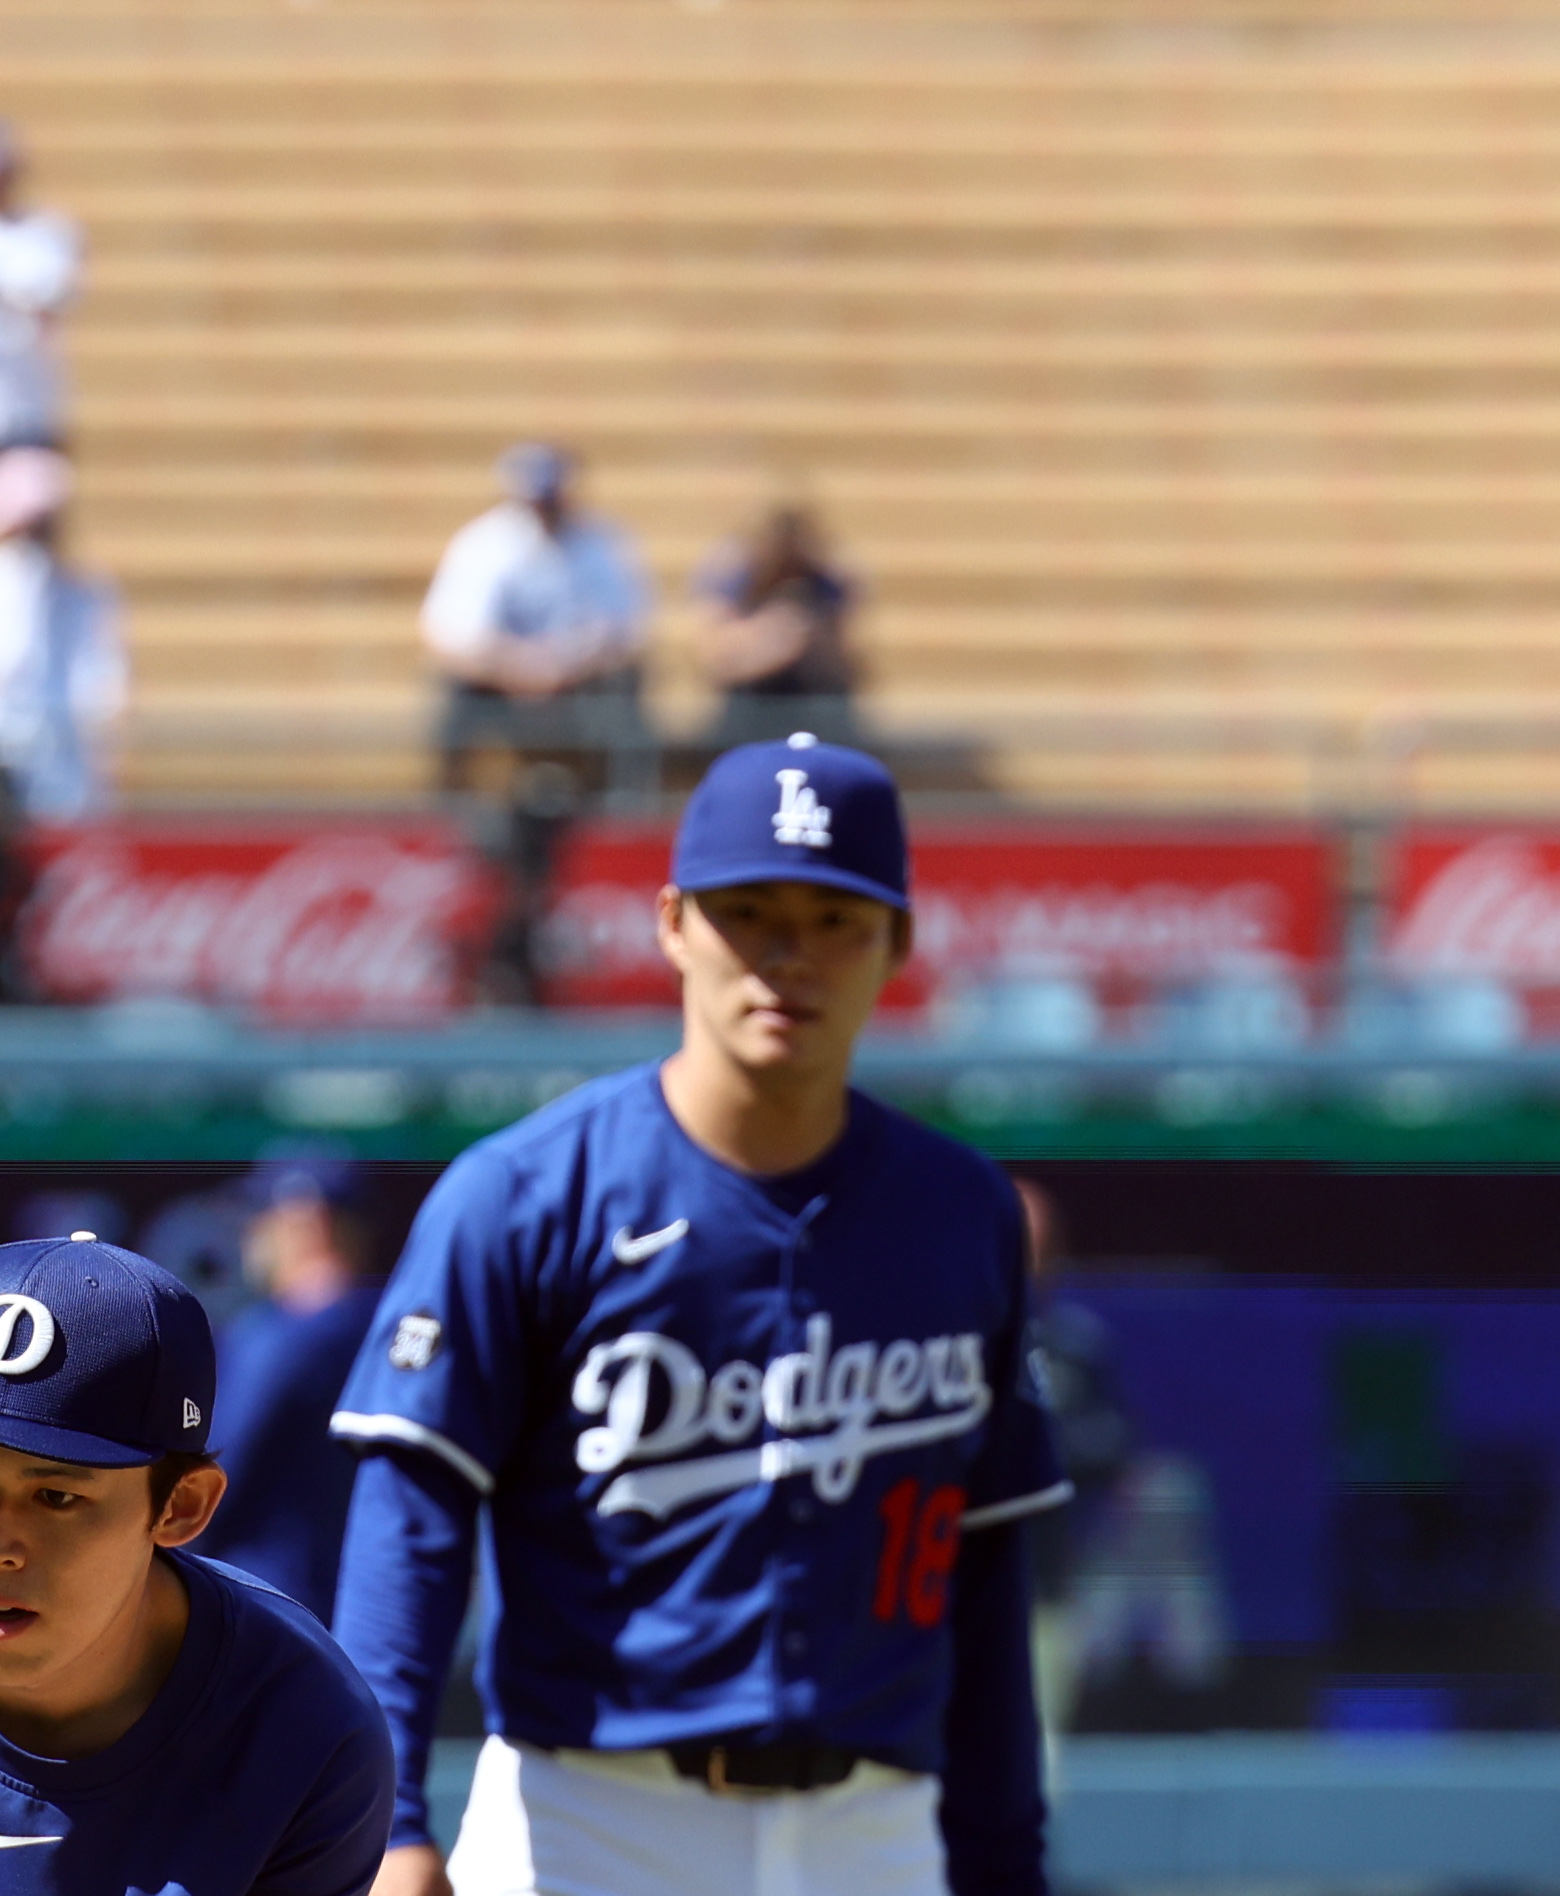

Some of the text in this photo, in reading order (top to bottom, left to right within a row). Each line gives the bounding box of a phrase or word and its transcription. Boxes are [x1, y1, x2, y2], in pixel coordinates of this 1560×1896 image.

[772, 768, 832, 847] LA
[572, 1311, 992, 1504] Dodgers
[874, 1476, 966, 1628] 18
